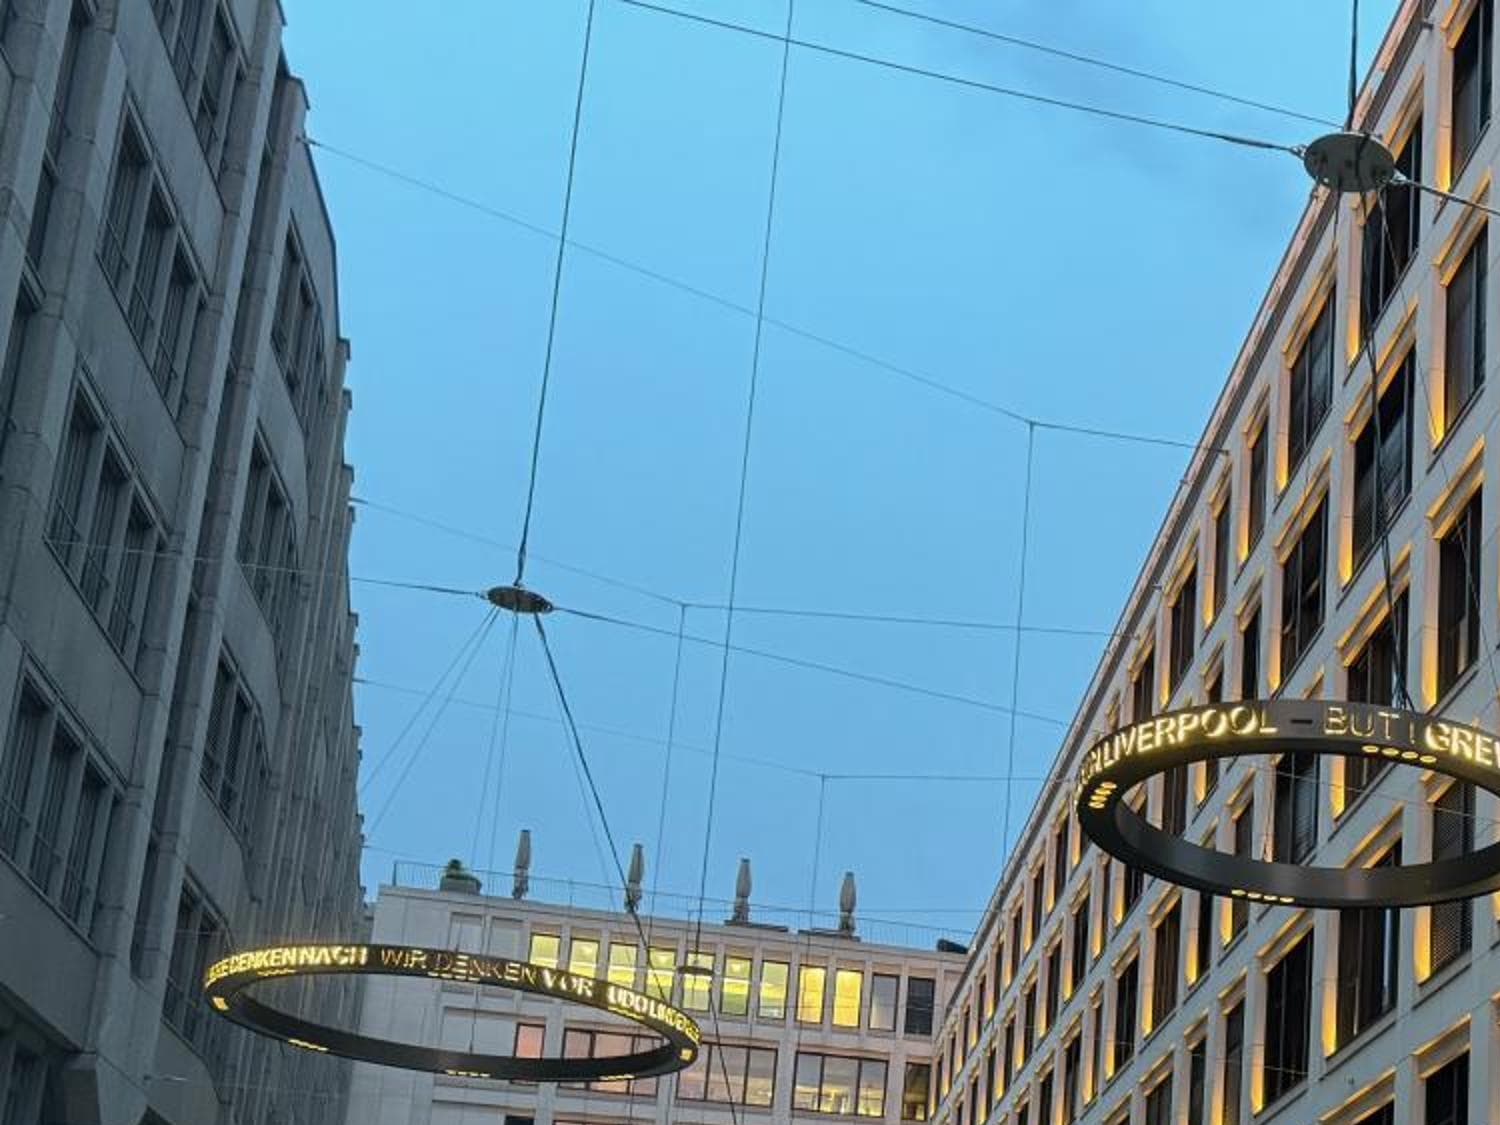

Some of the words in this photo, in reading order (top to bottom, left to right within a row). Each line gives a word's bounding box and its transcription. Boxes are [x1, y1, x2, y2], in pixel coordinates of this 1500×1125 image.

[1103, 706, 1278, 767] LIVERPOOL
[1324, 706, 1400, 740] BUT
[299, 946, 368, 966] NACH
[380, 948, 427, 970] WIR
[435, 952, 538, 985] DENKEN
[541, 968, 594, 998] VOR
